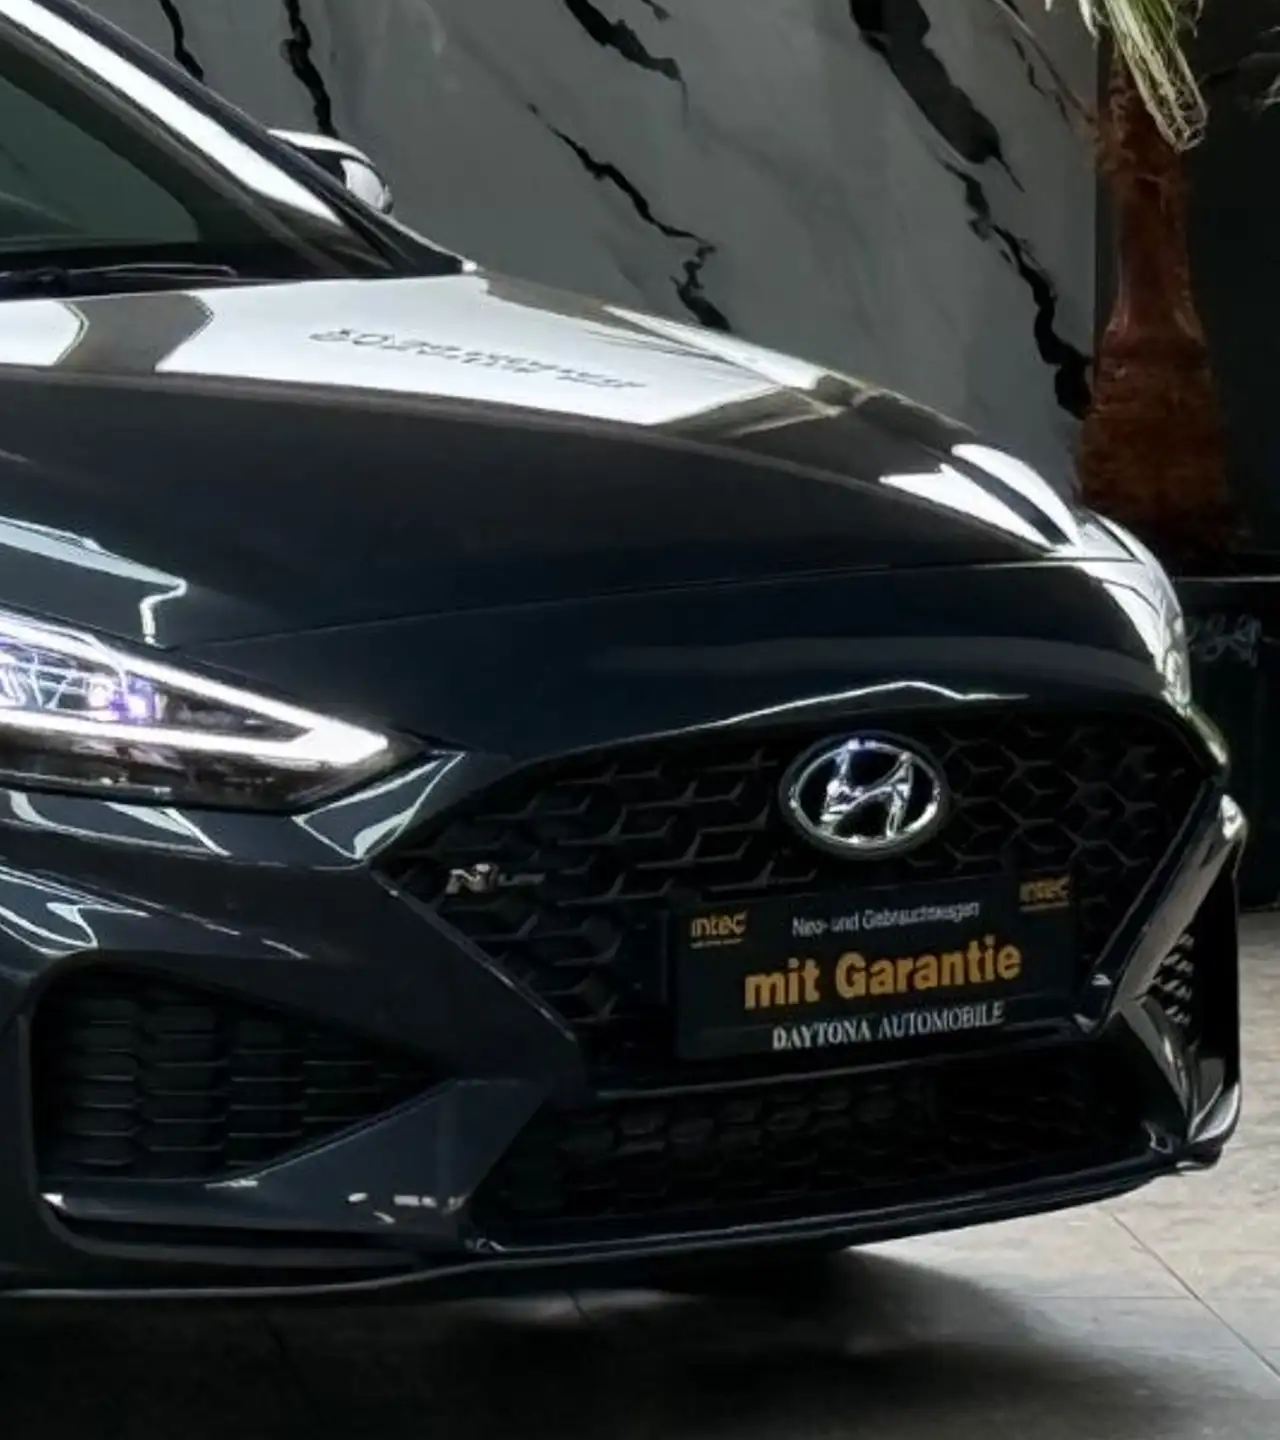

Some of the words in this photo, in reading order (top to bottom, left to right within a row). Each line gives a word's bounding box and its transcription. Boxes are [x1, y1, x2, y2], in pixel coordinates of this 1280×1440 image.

[744, 956, 821, 1010] mit
[834, 933, 1023, 1000] Garantie
[771, 1017, 872, 1051] DAYTONA
[877, 999, 1006, 1041] AUTOMOBILE
